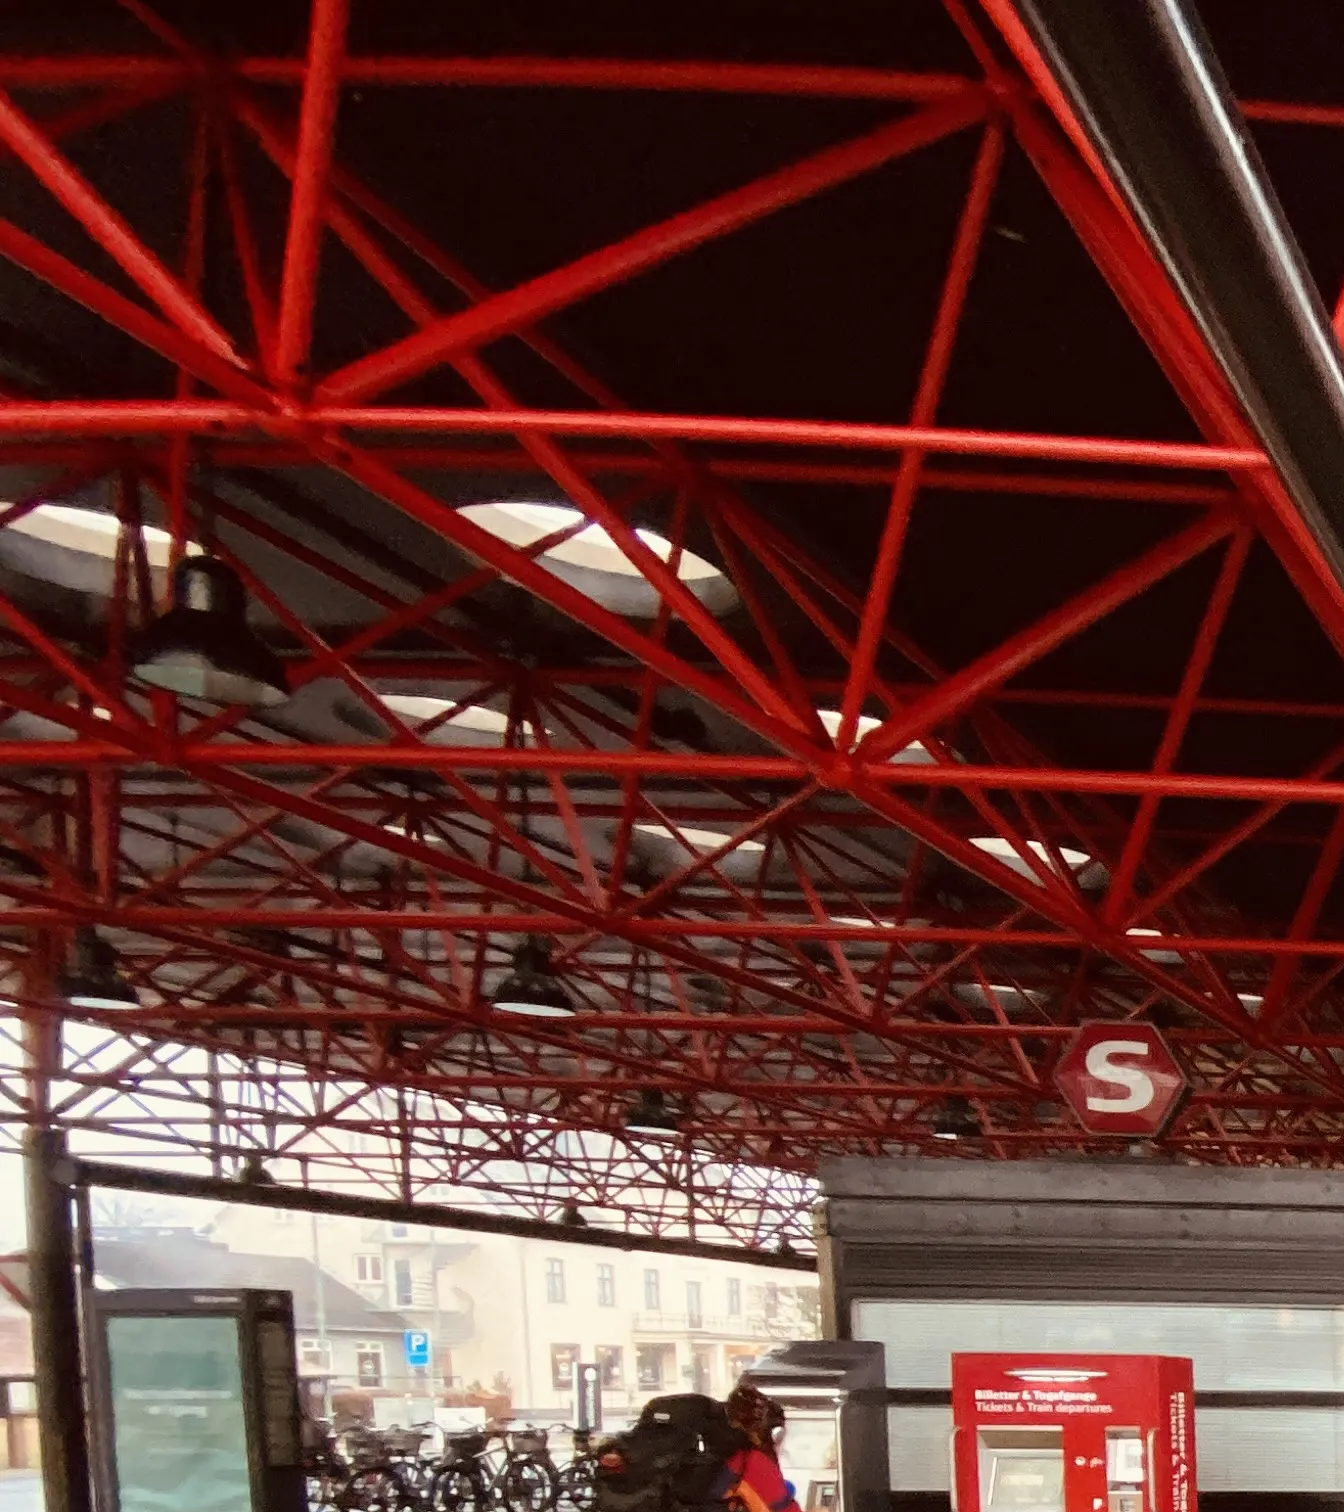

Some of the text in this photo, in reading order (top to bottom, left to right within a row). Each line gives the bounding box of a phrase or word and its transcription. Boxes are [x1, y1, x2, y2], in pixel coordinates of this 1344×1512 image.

[1085, 1040, 1154, 1113] S
[411, 1334, 425, 1352] P
[975, 1401, 1113, 1415] Tickets & Train departures
[1022, 1390, 1032, 1401] &
[1170, 1392, 1178, 1450] Tickets
[1172, 1470, 1181, 1512] Train
